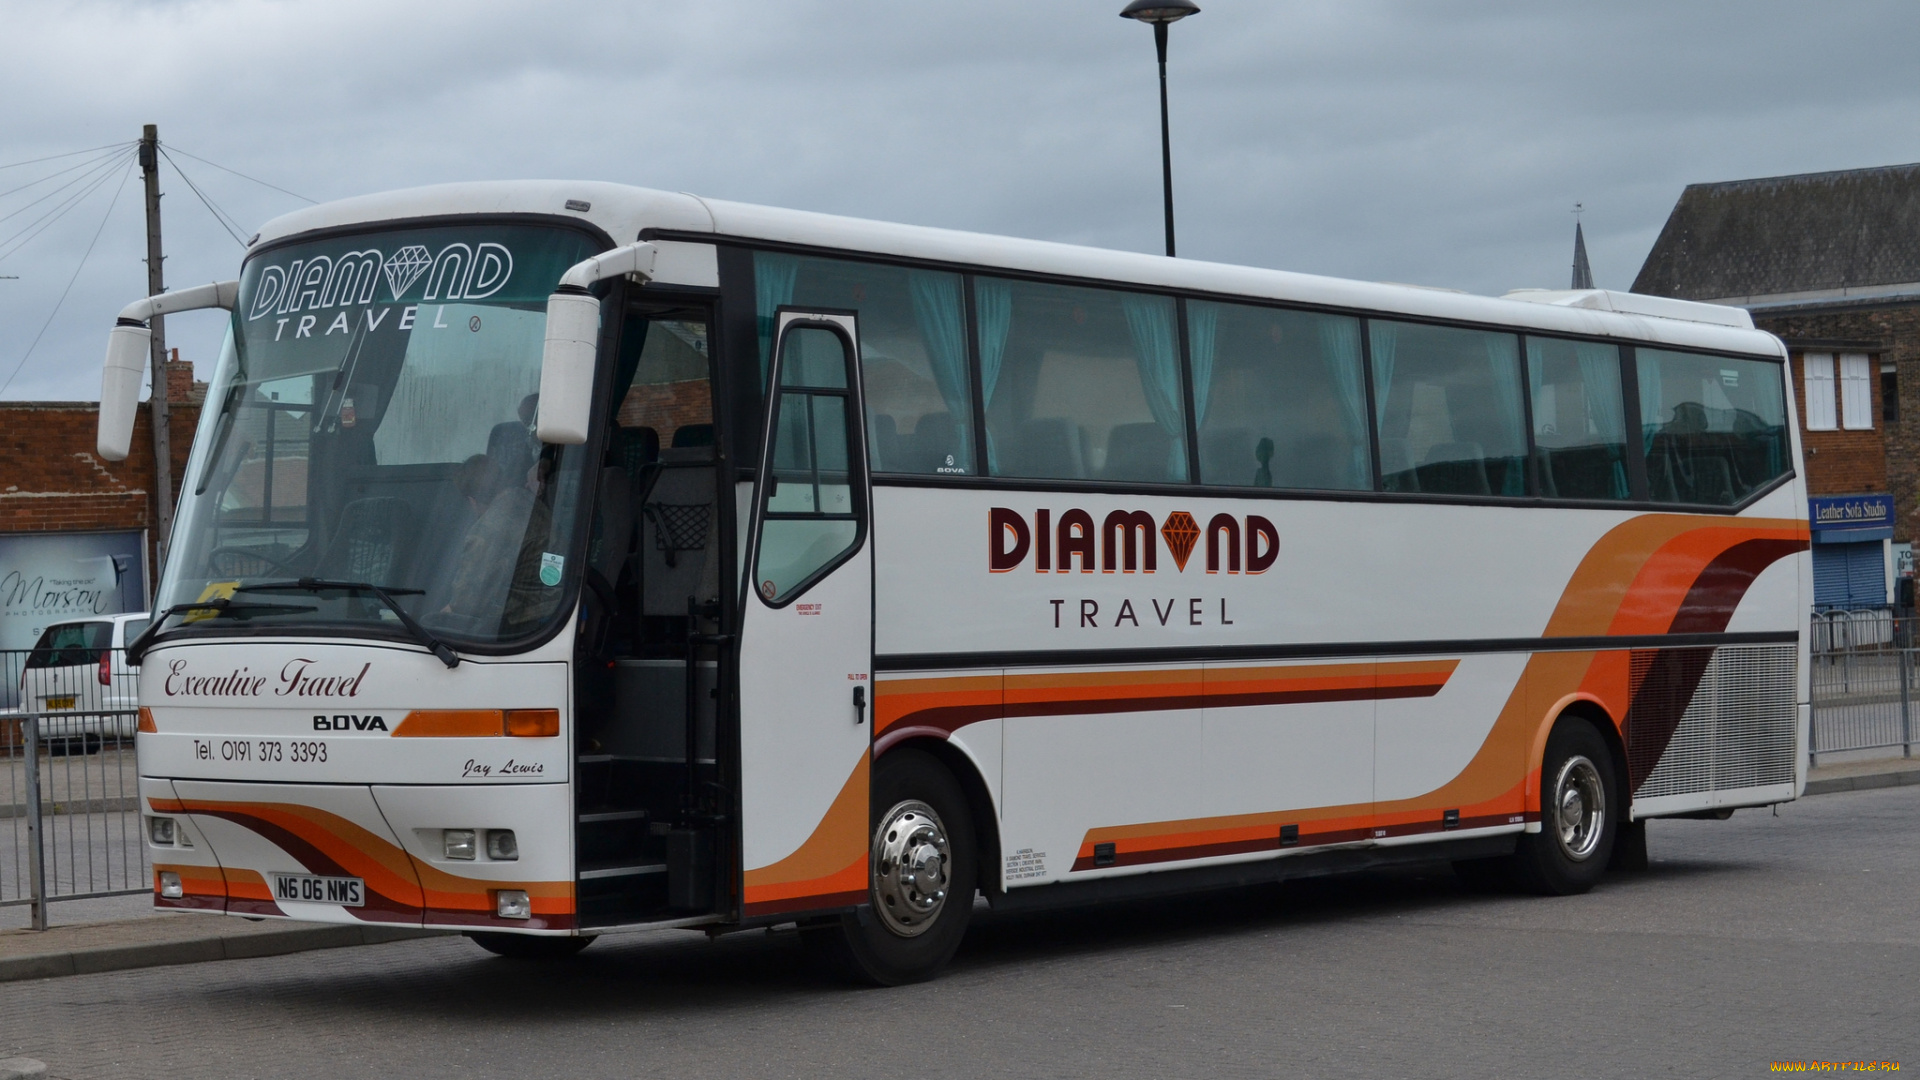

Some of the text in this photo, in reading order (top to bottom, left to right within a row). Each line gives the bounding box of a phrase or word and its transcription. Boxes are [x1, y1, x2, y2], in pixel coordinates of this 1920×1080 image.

[274, 305, 448, 342] TRAVEL
[1815, 500, 1887, 520] Leather Sofa Studio
[0, 571, 107, 614] Morson
[5, 608, 93, 616] PHOTOGRAPHY
[1050, 598, 1233, 628] TRAVEL
[164, 658, 371, 697] Executive Travel
[313, 715, 388, 732] BOVA
[194, 740, 328, 763] Tel. 0191 373 3393
[462, 759, 544, 778] Jay Lewis
[327, 880, 359, 903] NWS
